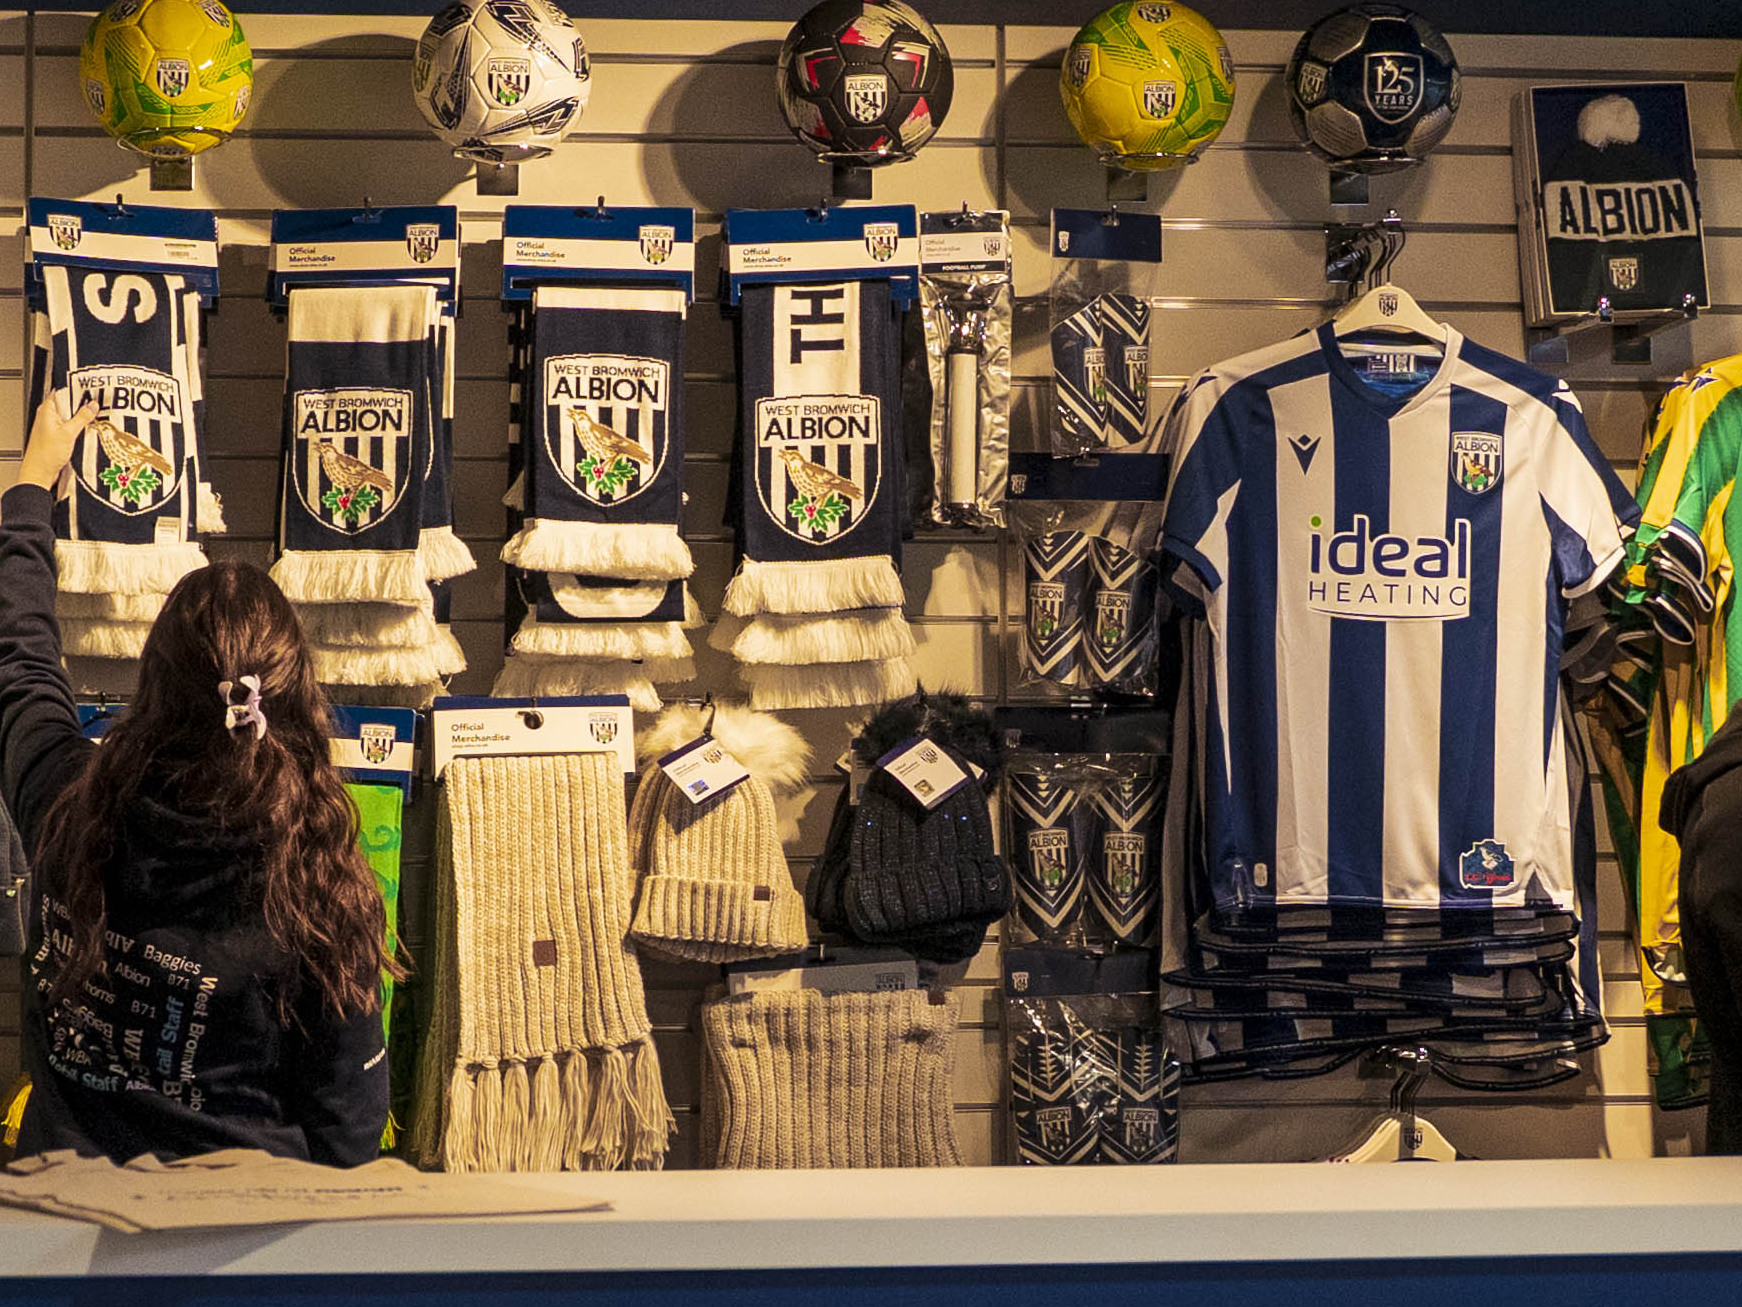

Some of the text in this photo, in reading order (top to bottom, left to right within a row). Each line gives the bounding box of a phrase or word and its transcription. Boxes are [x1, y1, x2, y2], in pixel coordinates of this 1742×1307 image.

[490, 64, 528, 73] ALBION
[848, 82, 884, 91] ALBION
[1374, 96, 1414, 106] YEARS
[1559, 183, 1692, 237] ALBION
[77, 375, 175, 392] WEST BROMWICH
[553, 365, 660, 378] WEST BROMWICH
[74, 386, 176, 417] ALBION
[551, 376, 660, 404] ALBION
[303, 398, 403, 410] WEST BROMWICH
[765, 404, 871, 416] WEST BROMWICH
[299, 409, 403, 434] ALBION
[763, 416, 871, 442] ALBION
[1455, 441, 1500, 453] ALBION
[1308, 514, 1468, 579] ideal
[1308, 580, 1468, 606] HEATING
[450, 723, 485, 732] Official
[451, 732, 511, 744] Merchandise
[143, 944, 202, 976] Baggies
[113, 961, 151, 988] Albion
[196, 976, 218, 1017] West
[161, 995, 184, 1044] Staff
